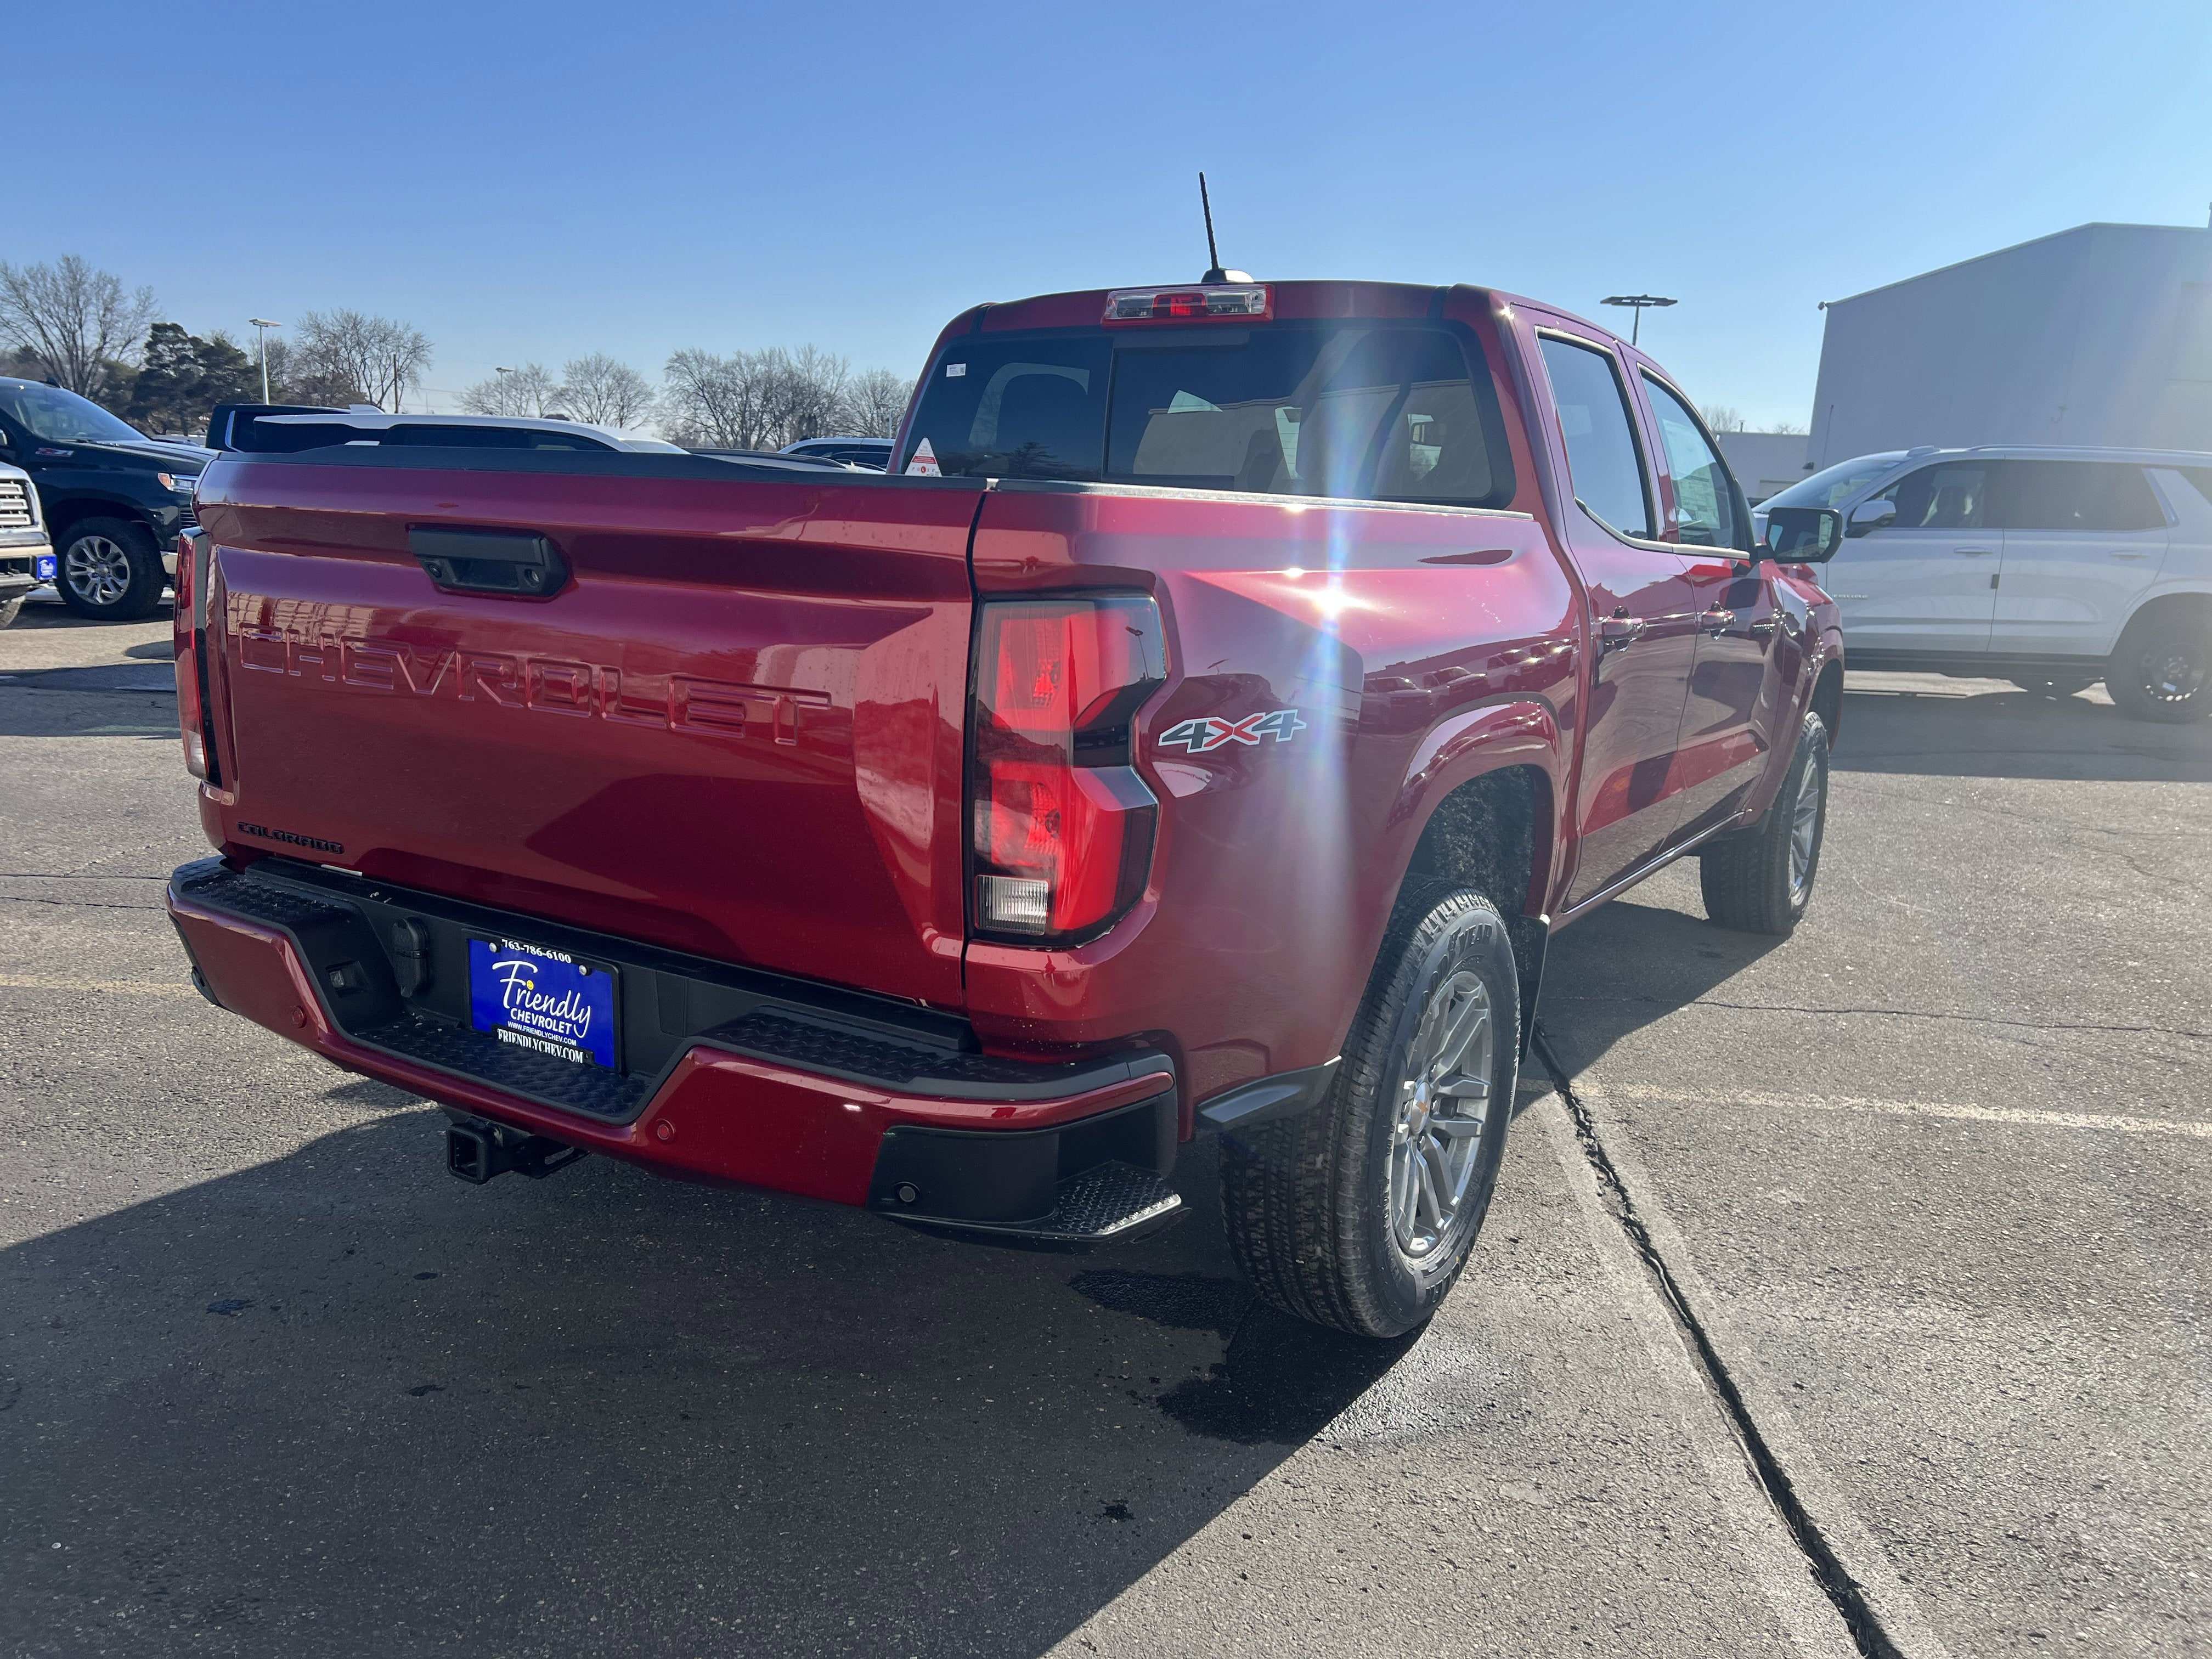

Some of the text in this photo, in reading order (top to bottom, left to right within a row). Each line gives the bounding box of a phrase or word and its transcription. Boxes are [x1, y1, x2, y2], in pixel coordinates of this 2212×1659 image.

[238, 622, 832, 746] CHEVROLET
[237, 821, 345, 854] COLORADO
[502, 939, 572, 963] 763-786-6100
[492, 960, 591, 1038] Friendly
[507, 1021, 577, 1046] WWW.FRIENDLYCHEV.COM
[510, 1007, 572, 1035] CHEVROLET
[498, 1028, 583, 1063] FRIENDLYCHEV.COM
